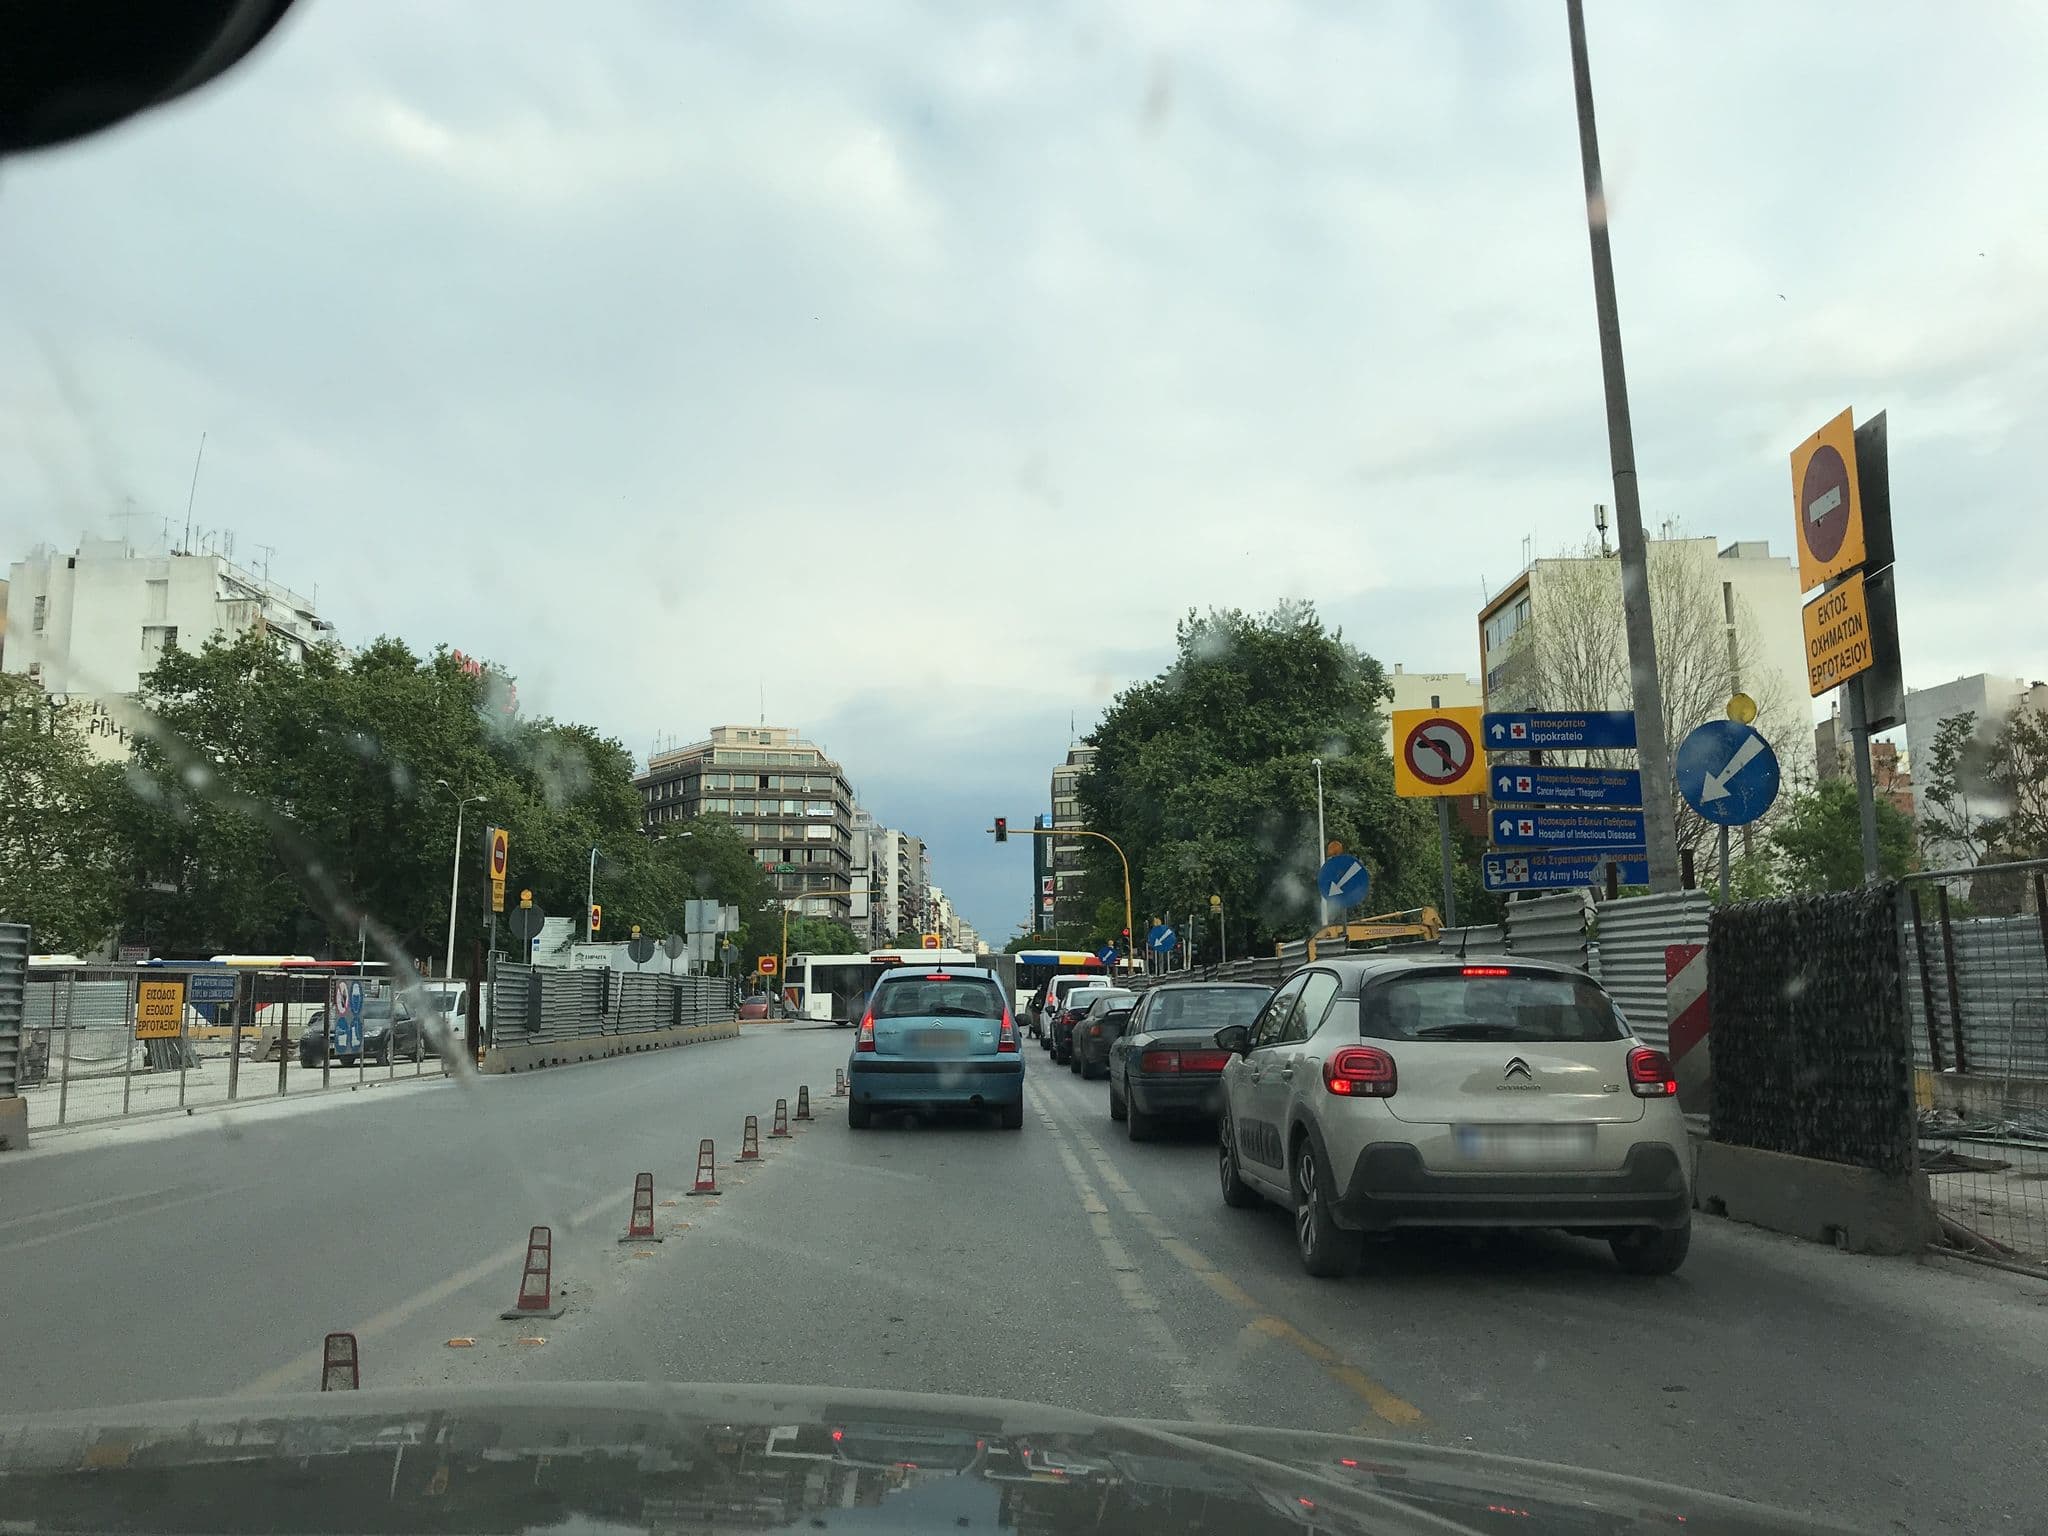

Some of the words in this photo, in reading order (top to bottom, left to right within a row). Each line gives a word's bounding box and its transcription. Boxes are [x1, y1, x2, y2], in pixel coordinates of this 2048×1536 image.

[1817, 591, 1848, 627] ΕΚΤΟΣ
[1810, 612, 1863, 657] ΟΧΗΜΑΤΩΝ
[1811, 639, 1867, 686] ΕΡΓΟΤΑΞΙΟΥ
[1531, 731, 1583, 743] Ippokrateio
[1536, 787, 1554, 796] Cancer
[1555, 787, 1576, 798] Hospital
[1538, 829, 1566, 841] Hospital
[1567, 830, 1573, 839] of
[1574, 829, 1606, 840] Infectious
[1607, 830, 1637, 840] Diseases
[1532, 855, 1547, 865] 424
[1533, 871, 1547, 881] 424
[1549, 870, 1570, 882] Army
[146, 989, 176, 1000] ΕΙΣΟΔΟΣ
[146, 1004, 174, 1015] ΕΞΟΔΟΣ
[138, 1020, 180, 1031] ΕΡΓΟΤΑΞΙΟΥ
